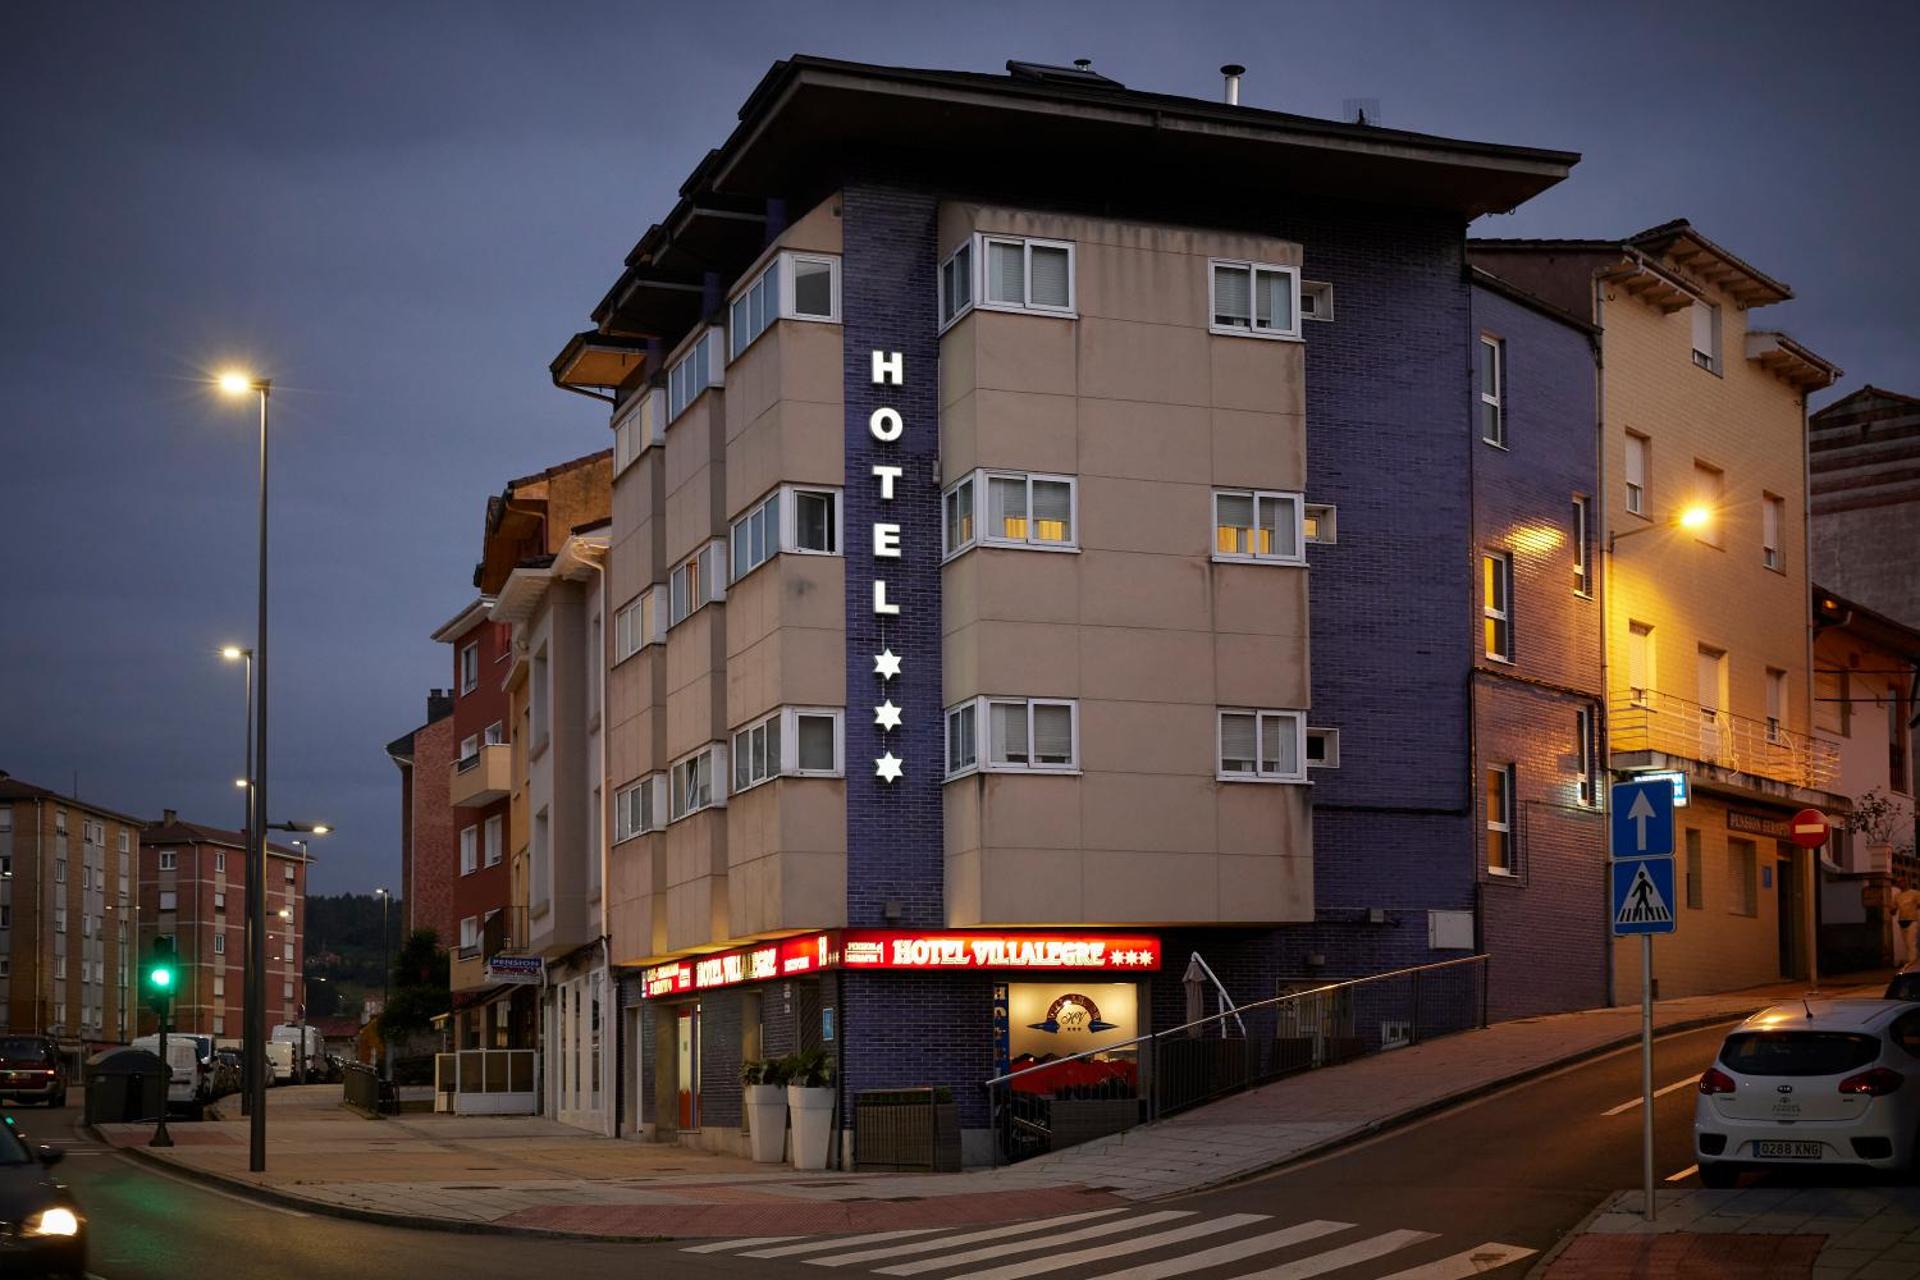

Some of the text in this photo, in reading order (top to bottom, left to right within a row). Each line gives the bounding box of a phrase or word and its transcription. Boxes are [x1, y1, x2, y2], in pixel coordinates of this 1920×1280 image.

[869, 350, 904, 616] HOTEL
[893, 939, 1106, 966] HOTEL VILLALEGRE
[1761, 1143, 1819, 1155] 0288 KNG
